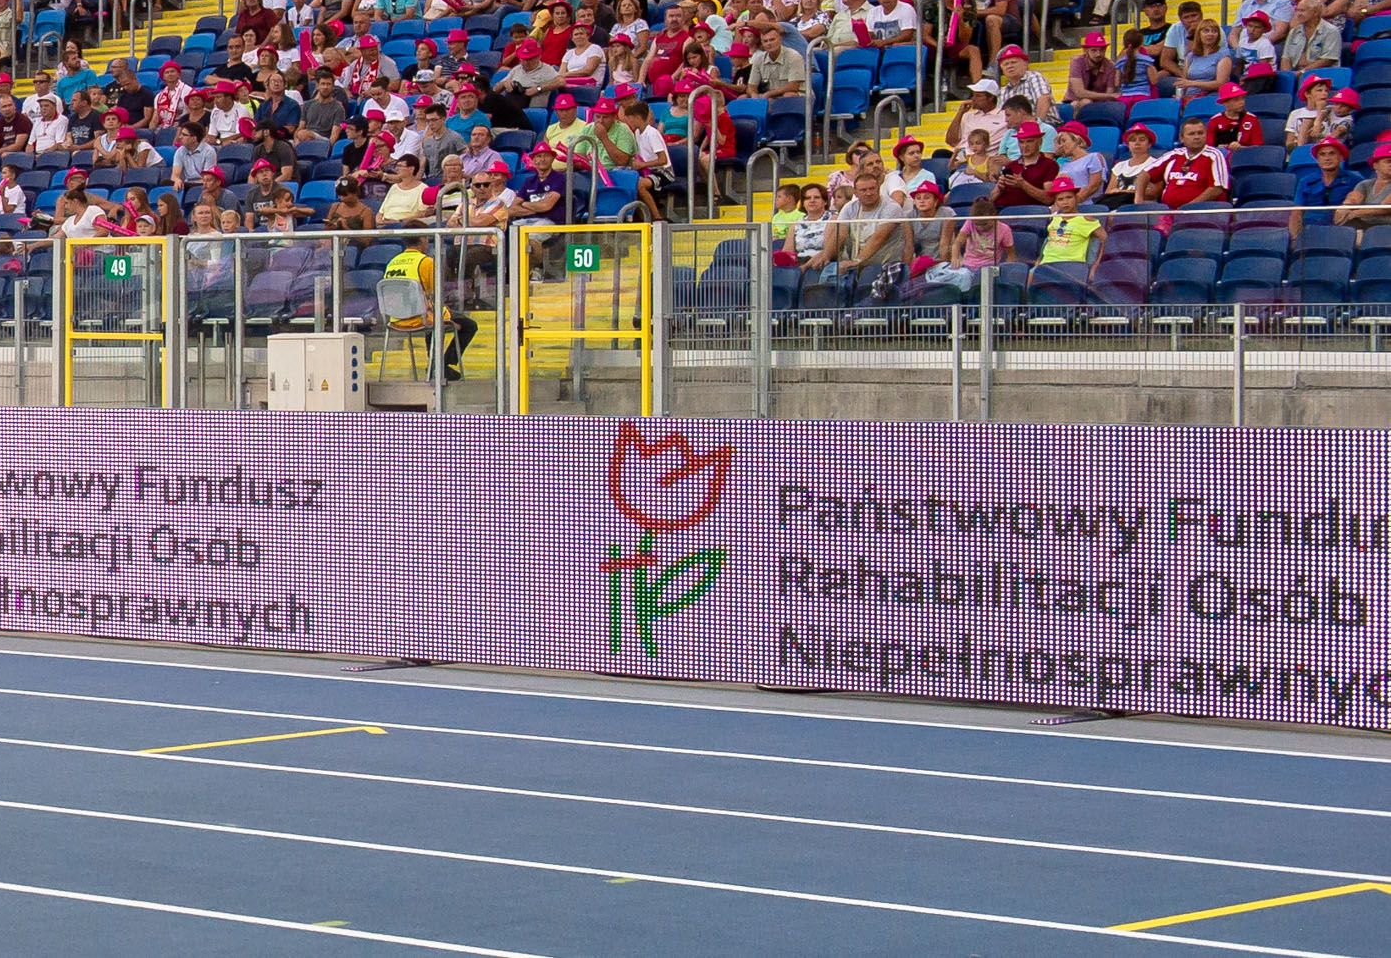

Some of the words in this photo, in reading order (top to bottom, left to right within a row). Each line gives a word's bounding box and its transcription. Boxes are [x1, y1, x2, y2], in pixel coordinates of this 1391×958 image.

[111, 259, 126, 276] 49
[574, 248, 593, 268] 50
[135, 464, 323, 511] Fundusz
[778, 482, 1149, 558] Państwowy
[151, 525, 261, 569] Osób
[778, 553, 1163, 632] Rehabilitacji
[1187, 572, 1369, 630] Osób
